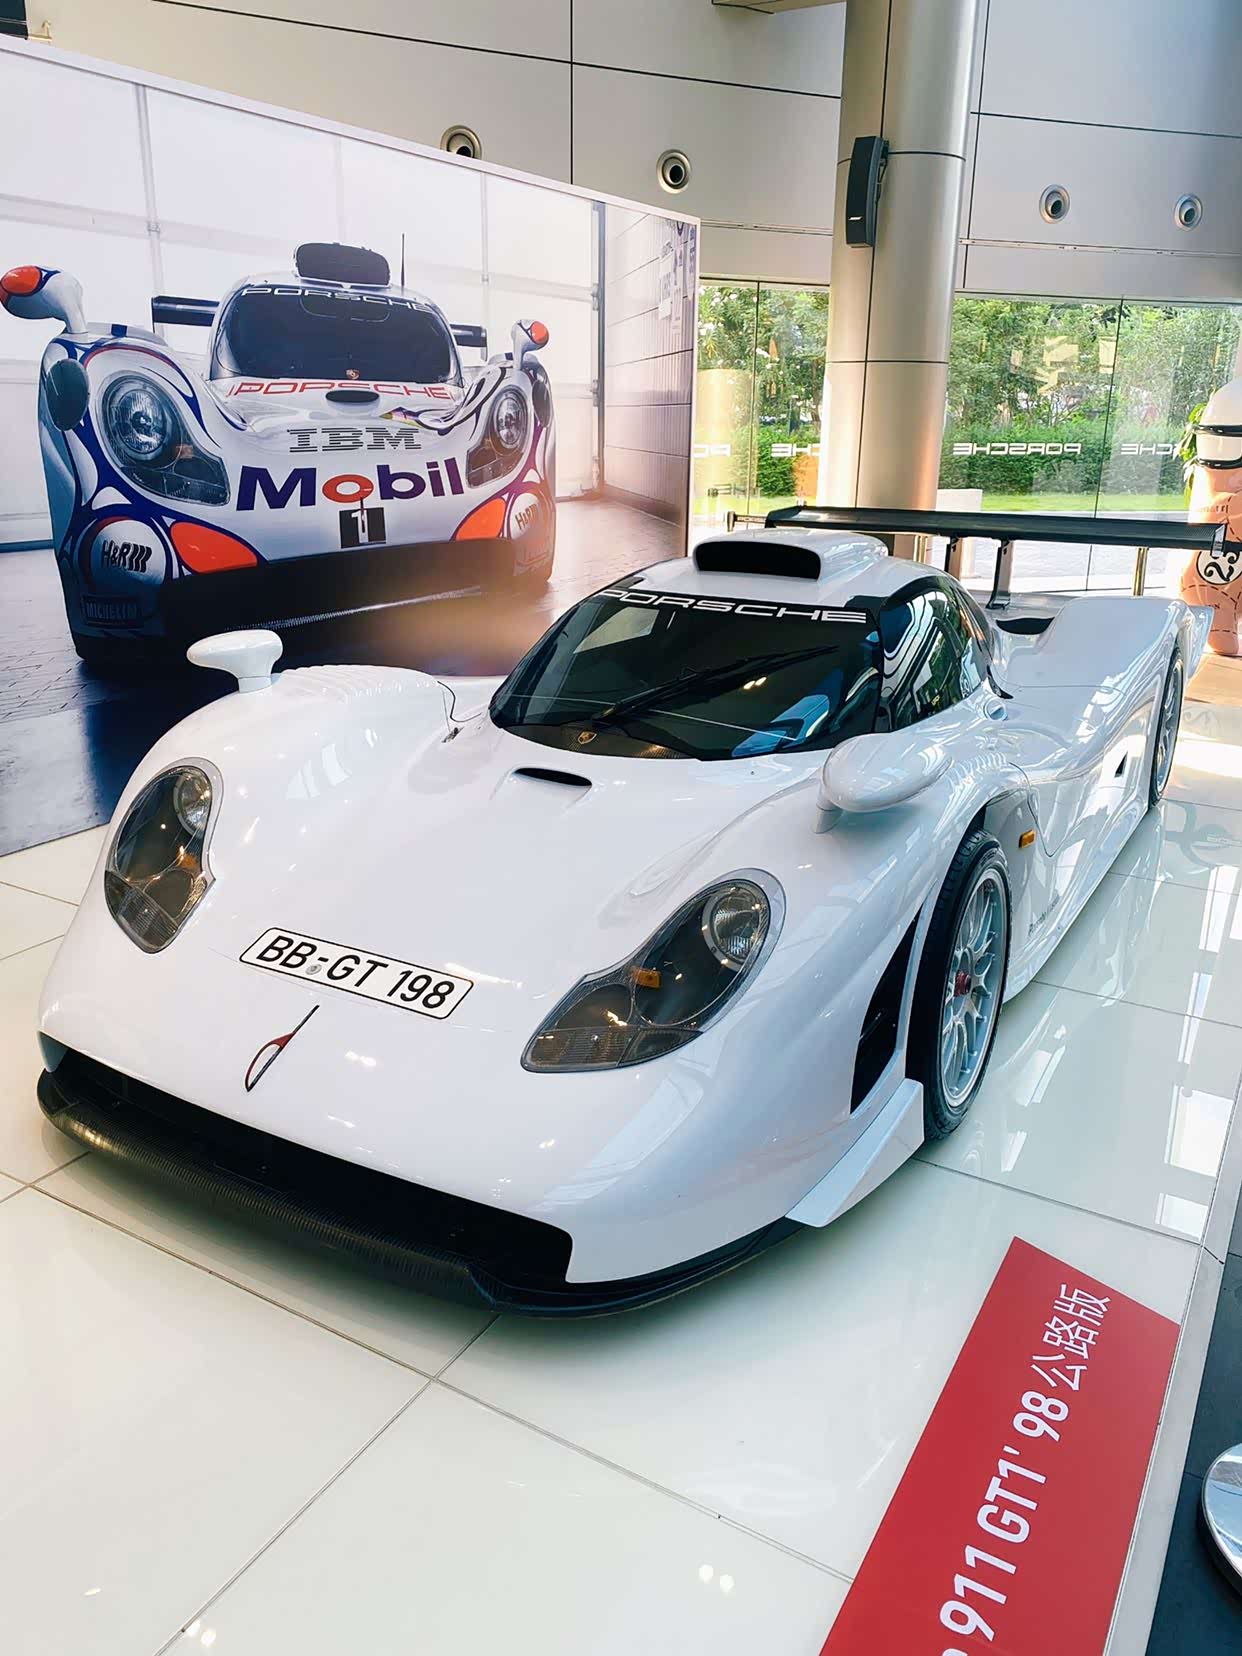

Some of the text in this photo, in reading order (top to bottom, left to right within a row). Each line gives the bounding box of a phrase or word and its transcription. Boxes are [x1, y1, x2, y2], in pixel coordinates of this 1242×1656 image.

[242, 287, 434, 314] PORSCHE
[234, 382, 452, 399] PORSCHE
[287, 427, 422, 453] IBM
[236, 457, 464, 511] Mobil
[594, 589, 867, 624] PORSCHE
[387, 970, 455, 1009] 198
[939, 1544, 1017, 1642] 911
[1030, 1283, 1112, 1391] 公路版
